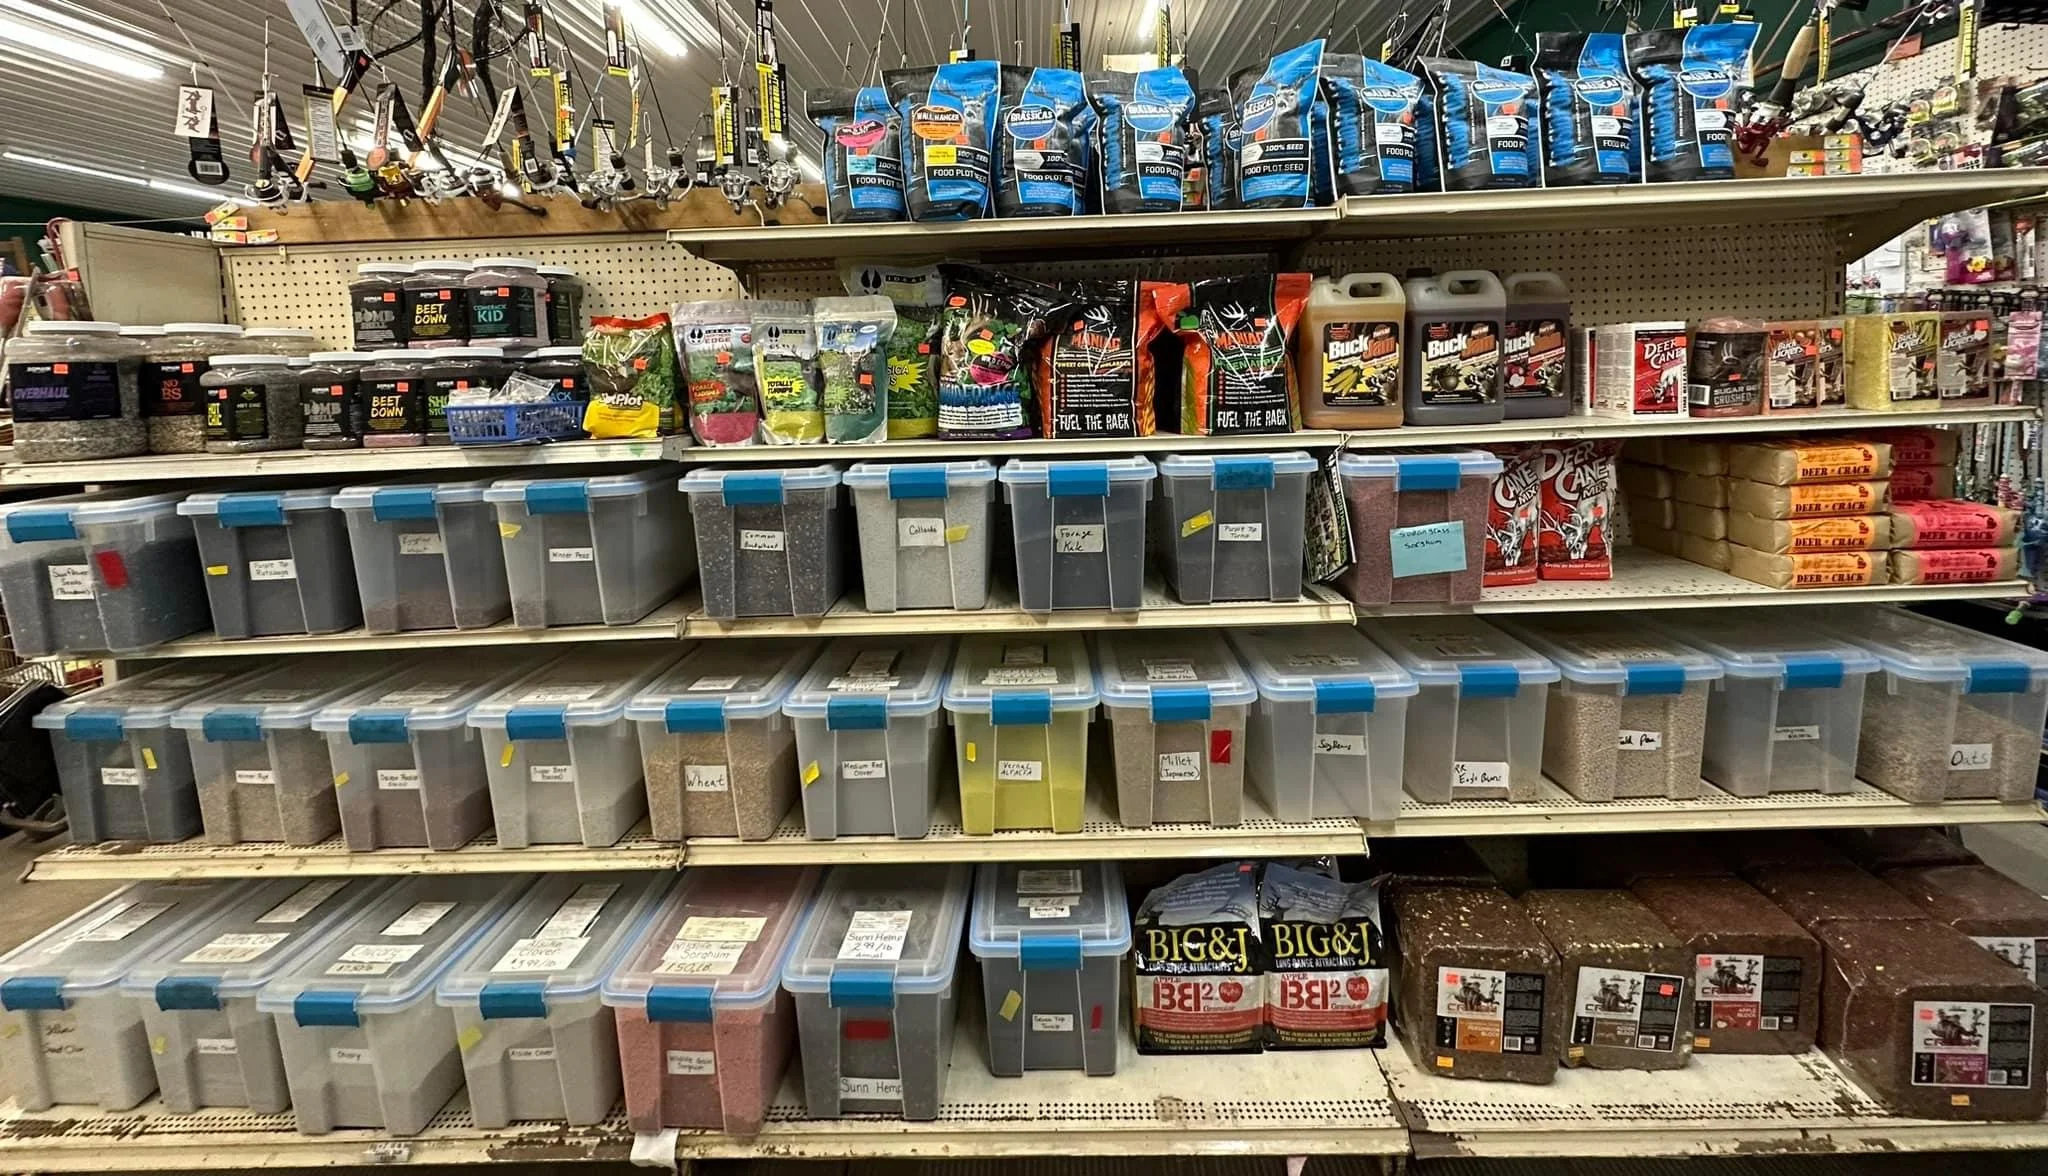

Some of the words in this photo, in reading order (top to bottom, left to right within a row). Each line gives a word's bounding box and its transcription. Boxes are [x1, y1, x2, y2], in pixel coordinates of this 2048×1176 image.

[917, 112, 933, 121] WALL
[934, 113, 959, 122] HANGER
[1011, 108, 1053, 122] BRASSICAS
[1265, 144, 1284, 152] 100%
[1285, 143, 1304, 152] SEED
[957, 150, 974, 158] 100%
[878, 162, 897, 171] 100%
[1145, 166, 1165, 174] FOOD
[1262, 164, 1282, 173] PLOT
[1283, 163, 1304, 172] SEED
[933, 168, 954, 178] FOOD
[955, 168, 974, 178] PLOT
[1023, 172, 1041, 181] FOOD
[1044, 174, 1062, 182] PLOT
[856, 177, 876, 186] FOOD
[877, 177, 895, 187] PLOT
[415, 303, 445, 315] BEET
[355, 308, 395, 323] BOMB
[414, 313, 447, 326] DOWN
[477, 309, 503, 324] KID
[1329, 334, 1369, 361] Buck
[1363, 337, 1395, 359] Jam
[1428, 333, 1468, 360] Buck
[1462, 336, 1495, 358] Jam
[1650, 348, 1682, 369] CANE
[13, 386, 70, 400] OVERHAUL
[1713, 384, 1745, 394] SUGAR
[372, 395, 401, 407] BEET
[1713, 394, 1752, 405] CRUSHED
[370, 406, 404, 419] DOWN
[1217, 410, 1239, 428] FUEL
[1241, 410, 1259, 427] THE
[1264, 408, 1287, 426] RACK
[1059, 414, 1083, 431] FUEL
[1084, 414, 1103, 431] THE
[1106, 413, 1130, 431] RACK
[1541, 440, 1601, 480] DEER
[1801, 468, 1828, 477] DEER
[1838, 465, 1871, 475] CRACK
[1494, 458, 1538, 509] CANE
[1556, 459, 1609, 501] CANE
[1581, 480, 1609, 499] MIX
[1517, 486, 1540, 506] MIX
[1795, 503, 1821, 513] DEER
[1832, 501, 1866, 511] CRACK
[744, 532, 776, 540] Common
[1060, 528, 1094, 540] Forage
[1919, 531, 1951, 540] DEER
[1957, 530, 1993, 540] CRACK
[1404, 539, 1443, 550] Sorghum
[1795, 537, 1822, 547] DEER
[1832, 536, 1866, 547] CRACK
[1796, 574, 1823, 584] DEER
[1832, 572, 1864, 582] CRACK
[1924, 571, 1950, 581] DEER
[1959, 570, 1993, 580] CRACK
[1161, 755, 1192, 767] Millet
[1951, 749, 1989, 767] Oats
[687, 774, 725, 788] Wheat
[847, 932, 872, 942] Sunn
[1271, 921, 1370, 966] BIG&J
[679, 949, 730, 961] Sorghum
[1146, 927, 1248, 973] BIG&J
[1315, 956, 1356, 967] ATTRACTANTS
[841, 1078, 869, 1093] Sunn
